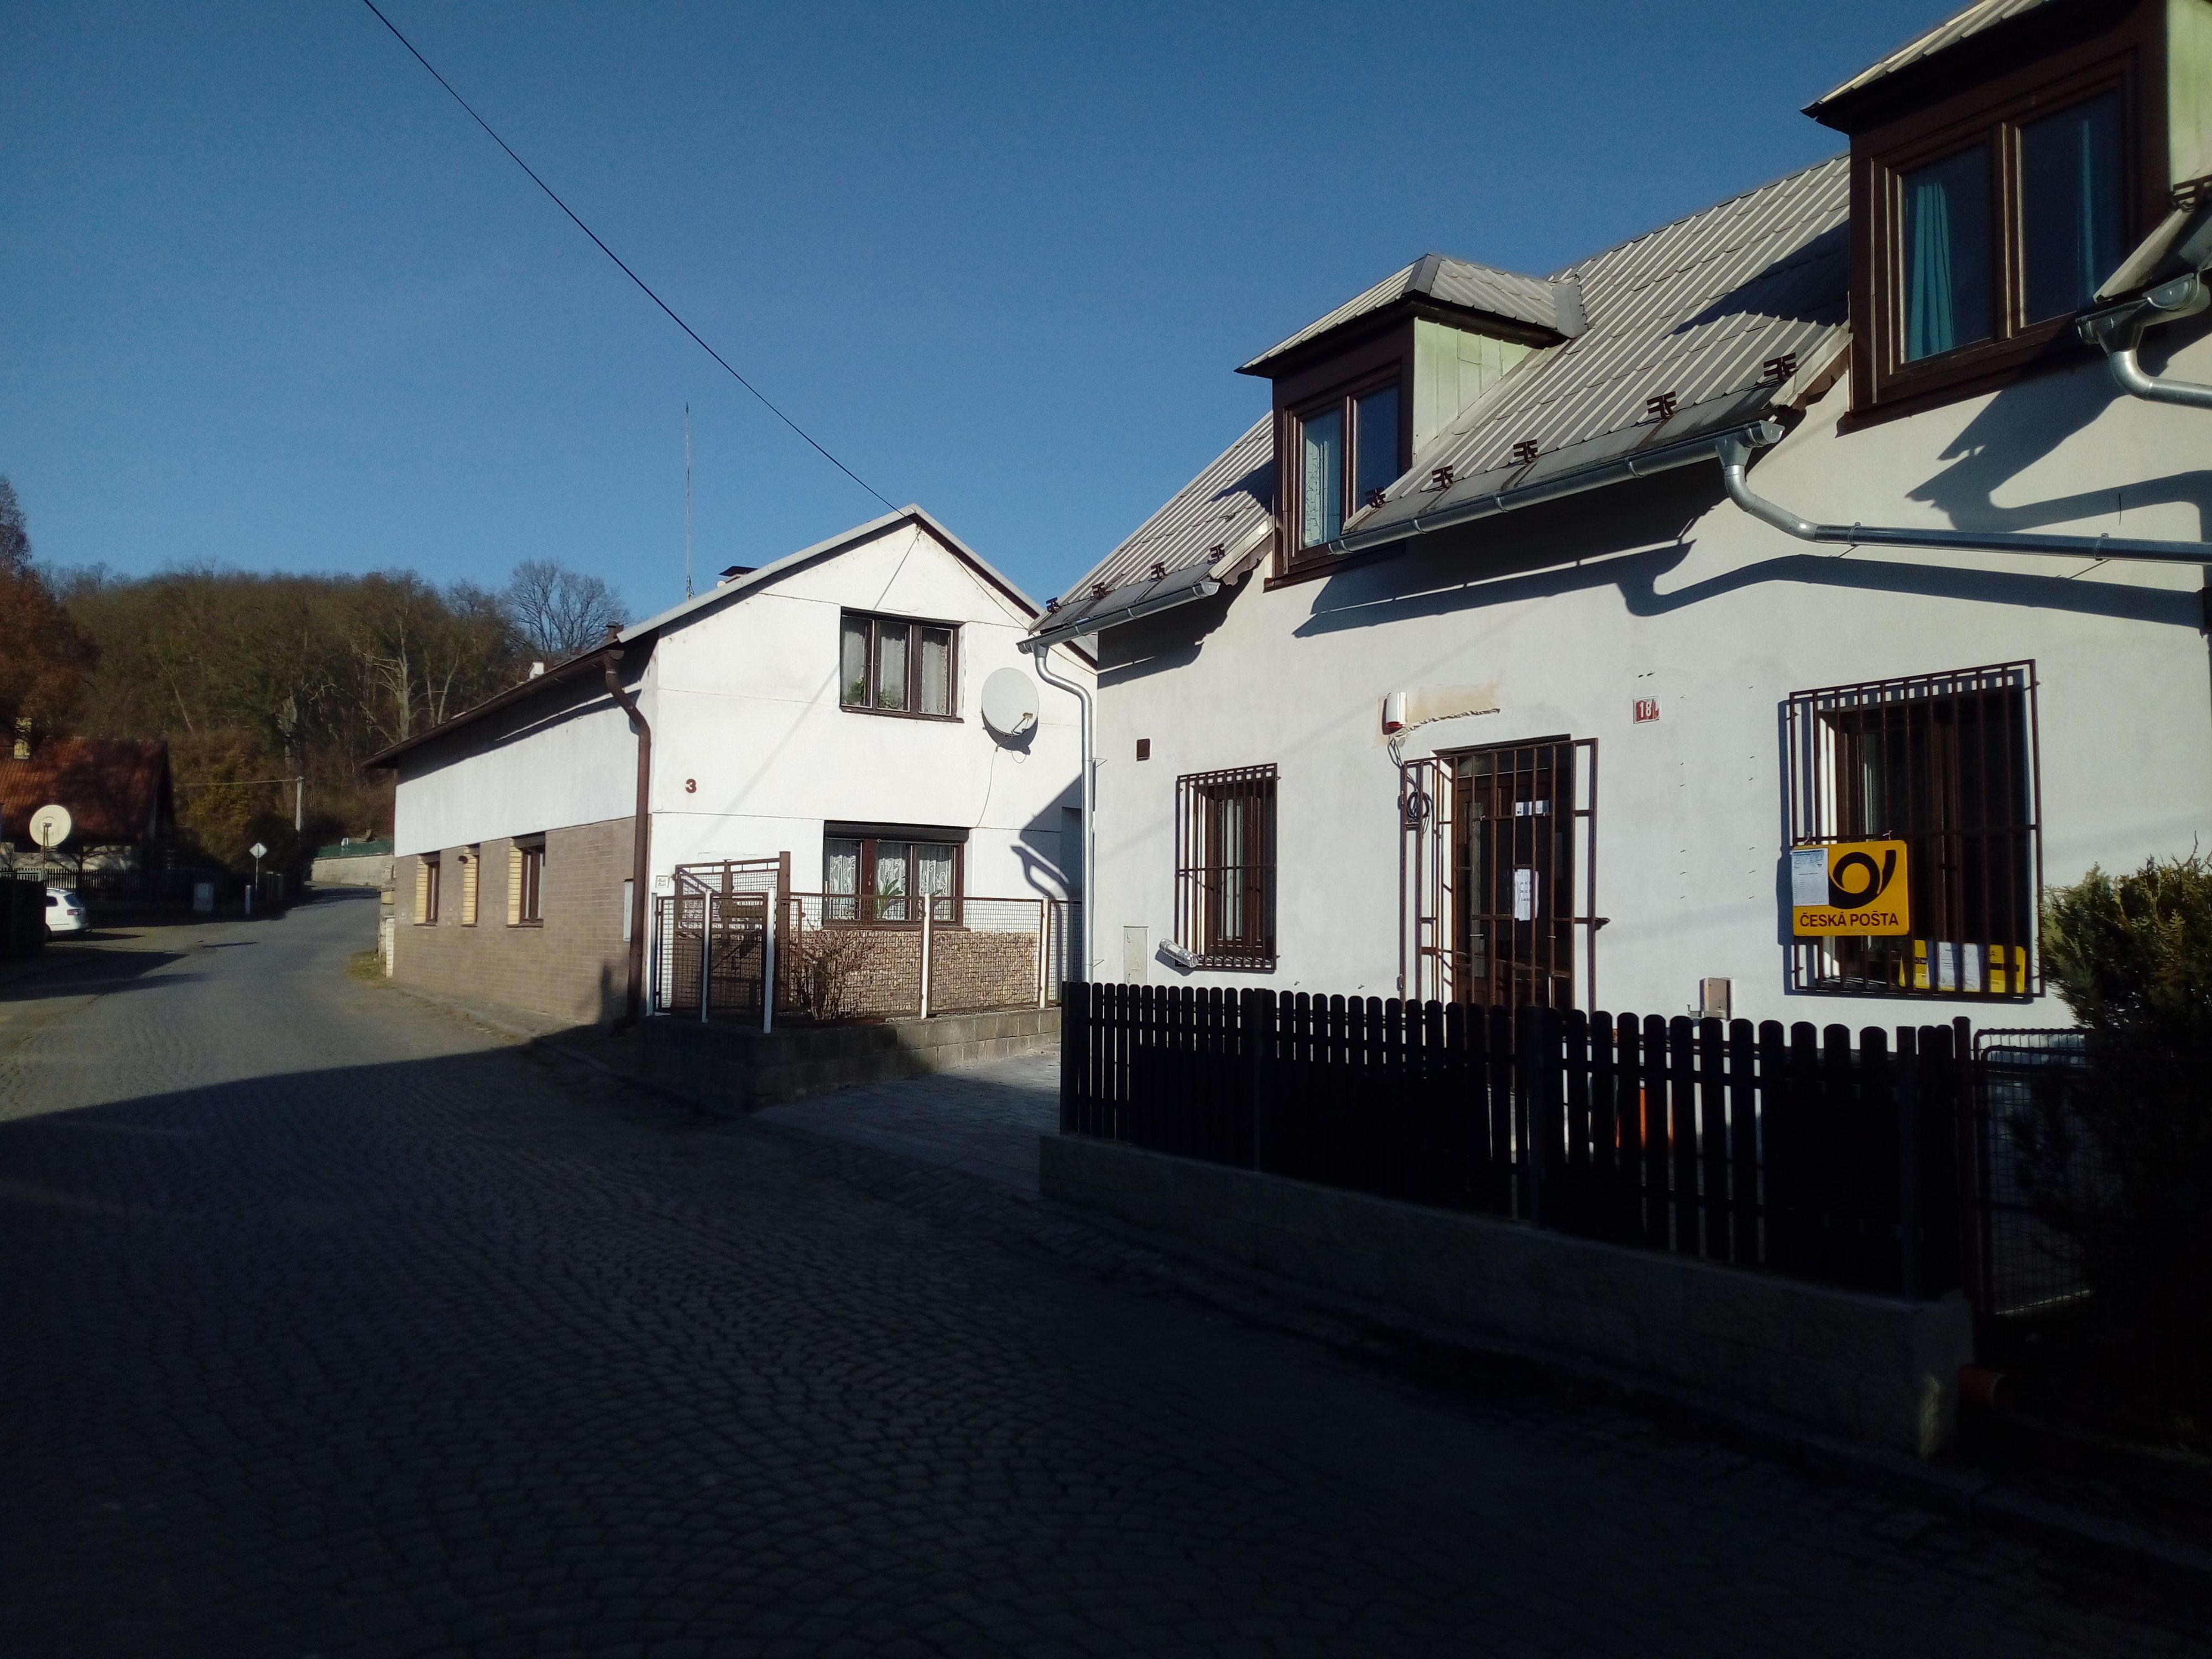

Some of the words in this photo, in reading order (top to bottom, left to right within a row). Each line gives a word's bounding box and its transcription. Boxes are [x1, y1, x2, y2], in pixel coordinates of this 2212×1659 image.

[685, 778, 697, 794] 3
[1800, 912, 1847, 927] ČESKÁ
[1850, 911, 1899, 926] POŠTA
